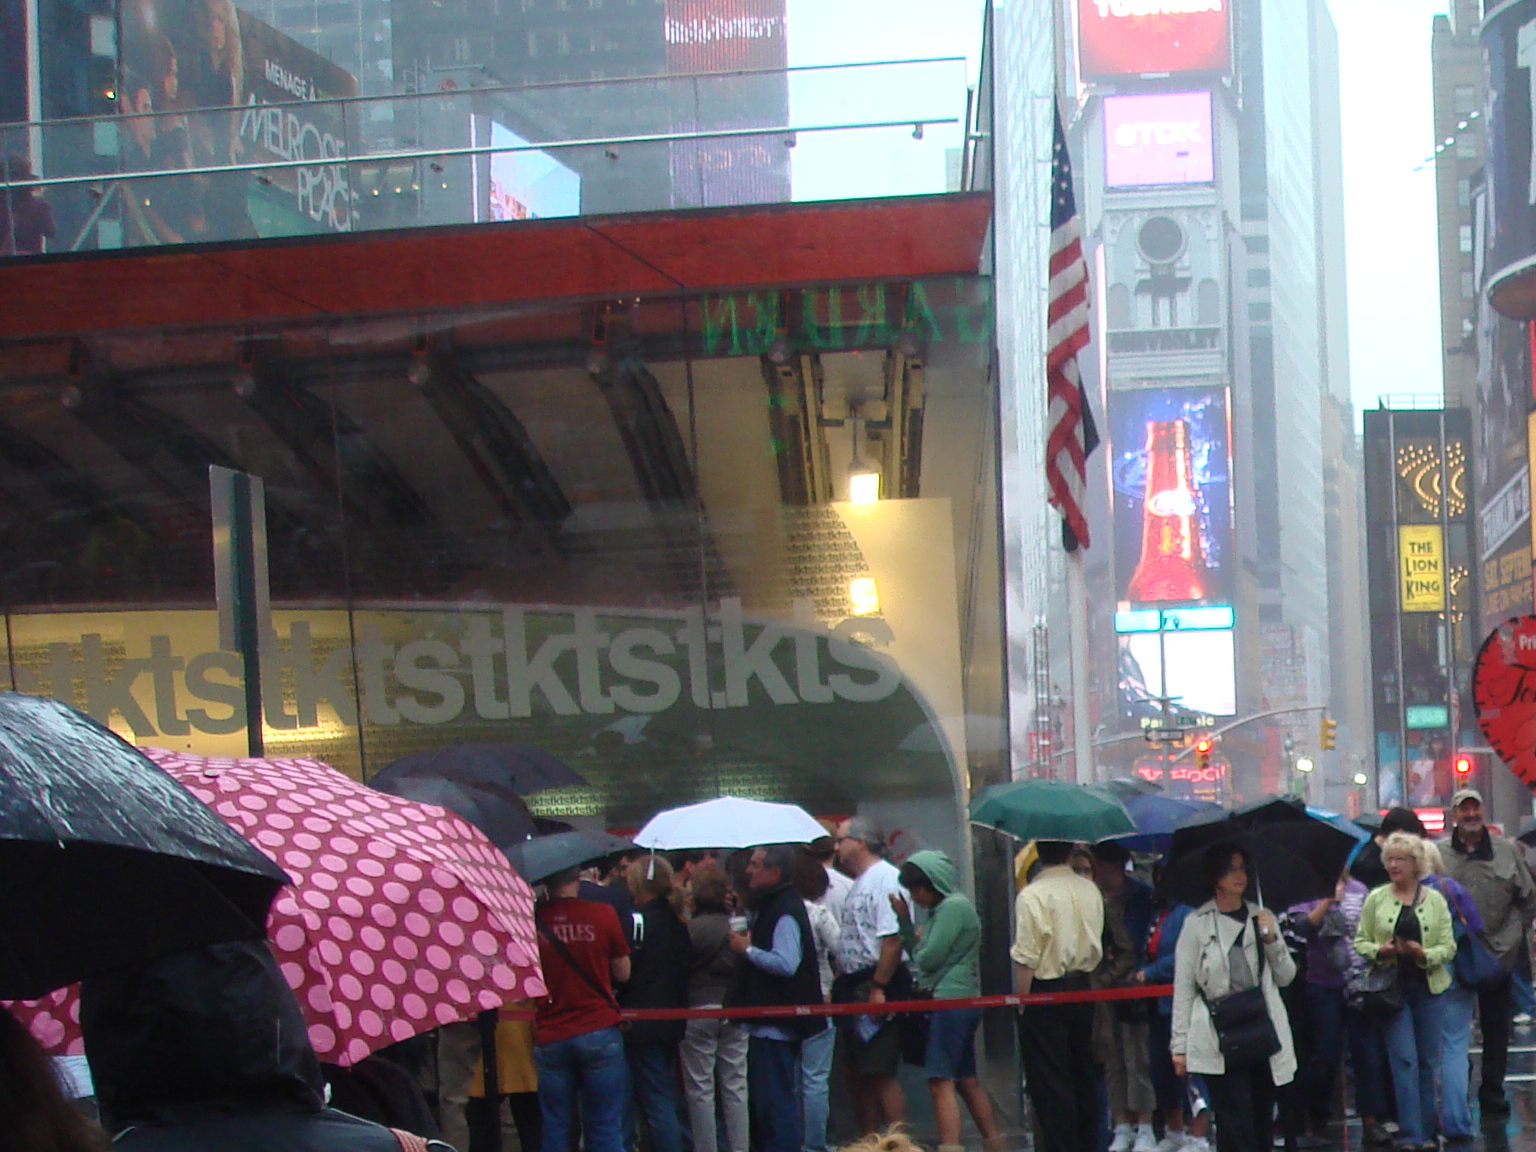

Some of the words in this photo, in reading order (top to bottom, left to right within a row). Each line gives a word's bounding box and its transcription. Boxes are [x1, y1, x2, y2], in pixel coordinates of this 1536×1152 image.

[1409, 541, 1433, 554] THE
[1405, 557, 1438, 577] LION
[1405, 580, 1440, 600] KING
